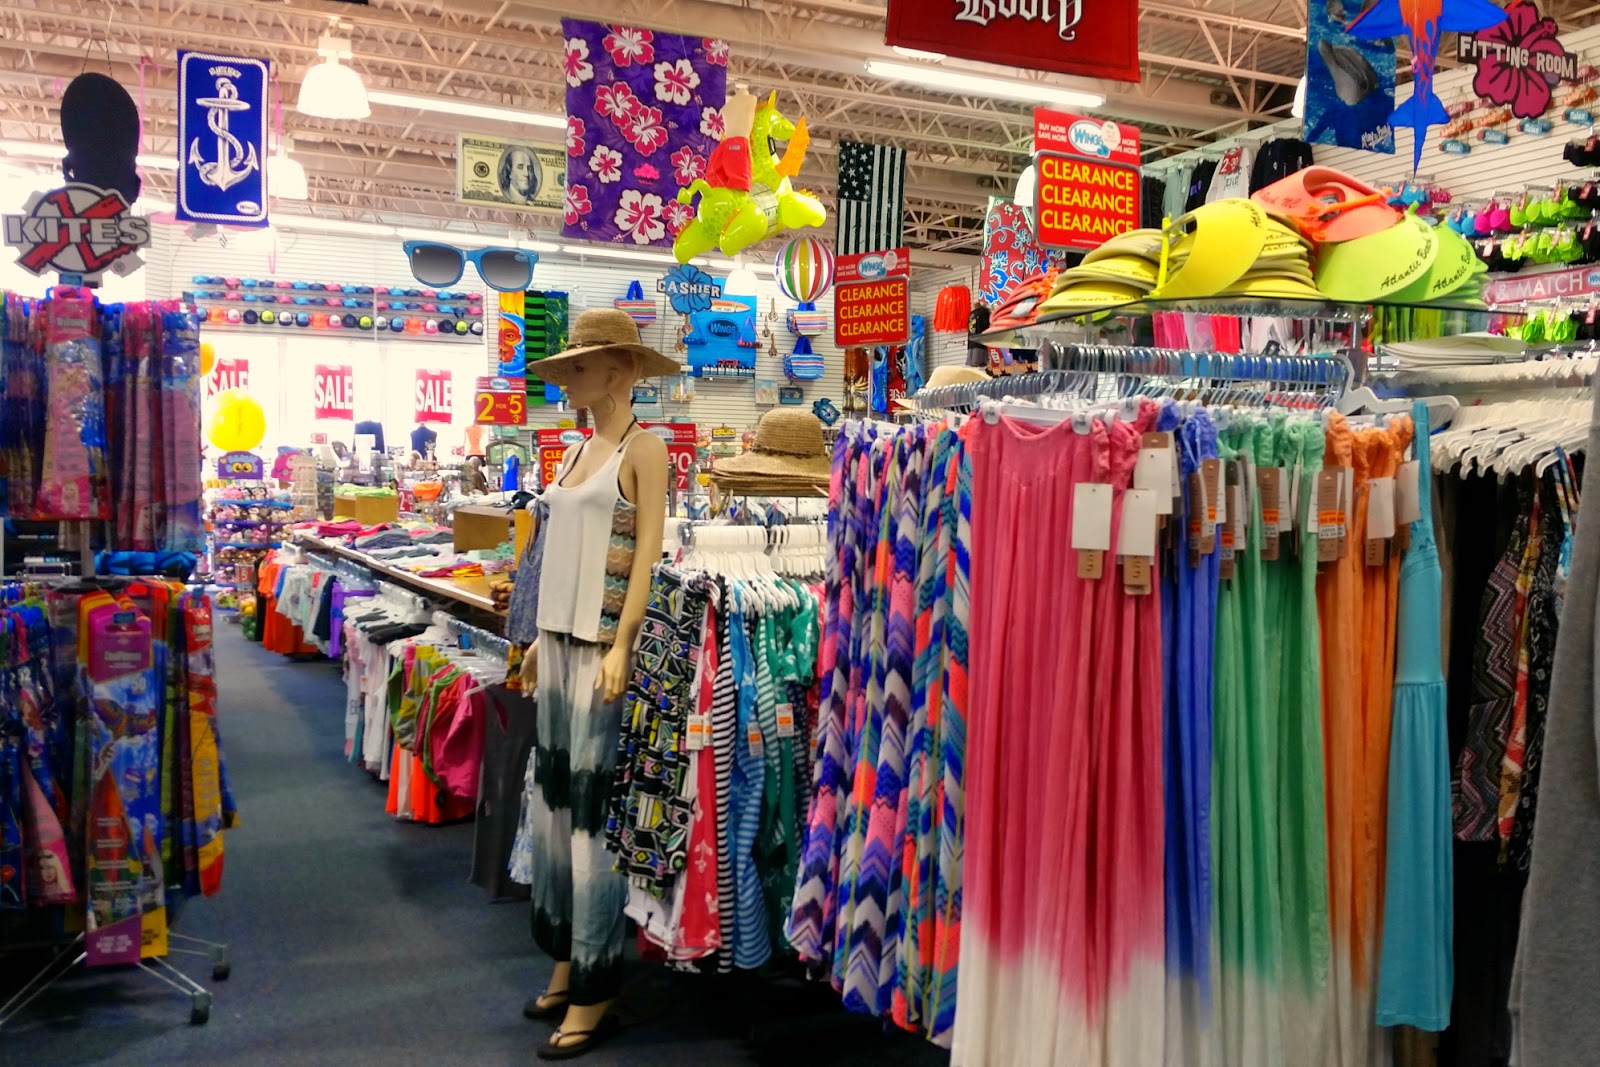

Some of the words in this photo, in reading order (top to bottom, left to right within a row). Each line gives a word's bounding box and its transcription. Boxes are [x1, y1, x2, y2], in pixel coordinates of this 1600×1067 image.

[1460, 35, 1529, 69] FITTING
[1536, 52, 1574, 79] ROOM
[1037, 131, 1051, 140] SAVE
[1052, 134, 1068, 143] MORE
[1038, 122, 1050, 131] BUY
[1050, 125, 1067, 134] MORE
[1123, 147, 1138, 155] MORE
[1041, 159, 1134, 191] CLEARANCE
[1041, 184, 1134, 215] CLEARANCE
[6, 215, 150, 246] KITES
[1041, 209, 1134, 236] CLEARANCE
[657, 280, 720, 298] CASHIER
[1380, 260, 1422, 291] Atlantic
[1432, 265, 1467, 293] Atlantic
[1516, 271, 1583, 298] MATCH
[839, 282, 904, 303] CLEARANCE
[839, 300, 904, 320] CLEARANCE
[709, 323, 737, 334] WINGS
[839, 318, 904, 337] CLEARANCE
[315, 374, 354, 410] SALE
[415, 379, 452, 414] SALE
[476, 393, 495, 421] 2
[669, 452, 693, 473] 10
